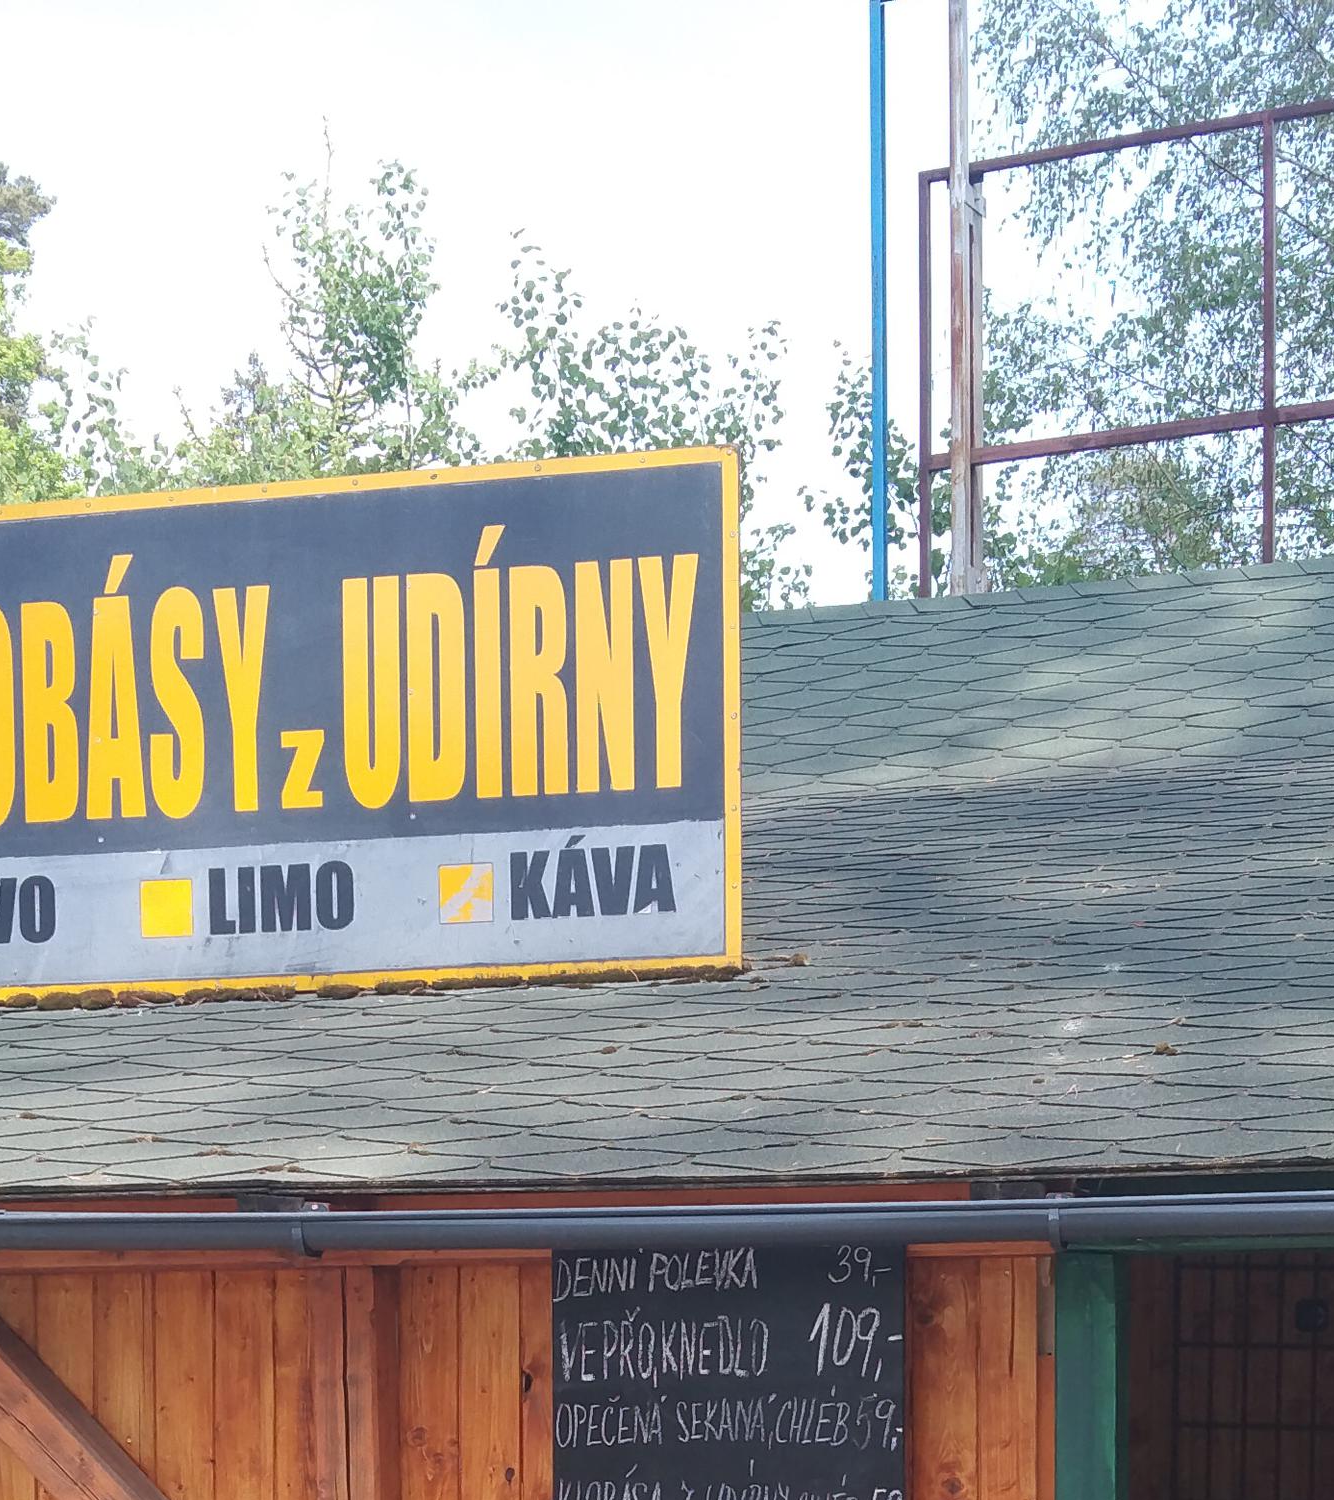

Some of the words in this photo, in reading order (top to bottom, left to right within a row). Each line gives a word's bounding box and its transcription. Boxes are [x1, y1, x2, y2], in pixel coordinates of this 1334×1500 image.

[279, 729, 324, 809] z
[342, 524, 698, 810] UDÍRNY
[207, 860, 355, 936] LIMO
[509, 834, 677, 921] KÁVA
[808, 1302, 903, 1382] 109,-
[555, 1394, 667, 1448] OPEČENÁ
